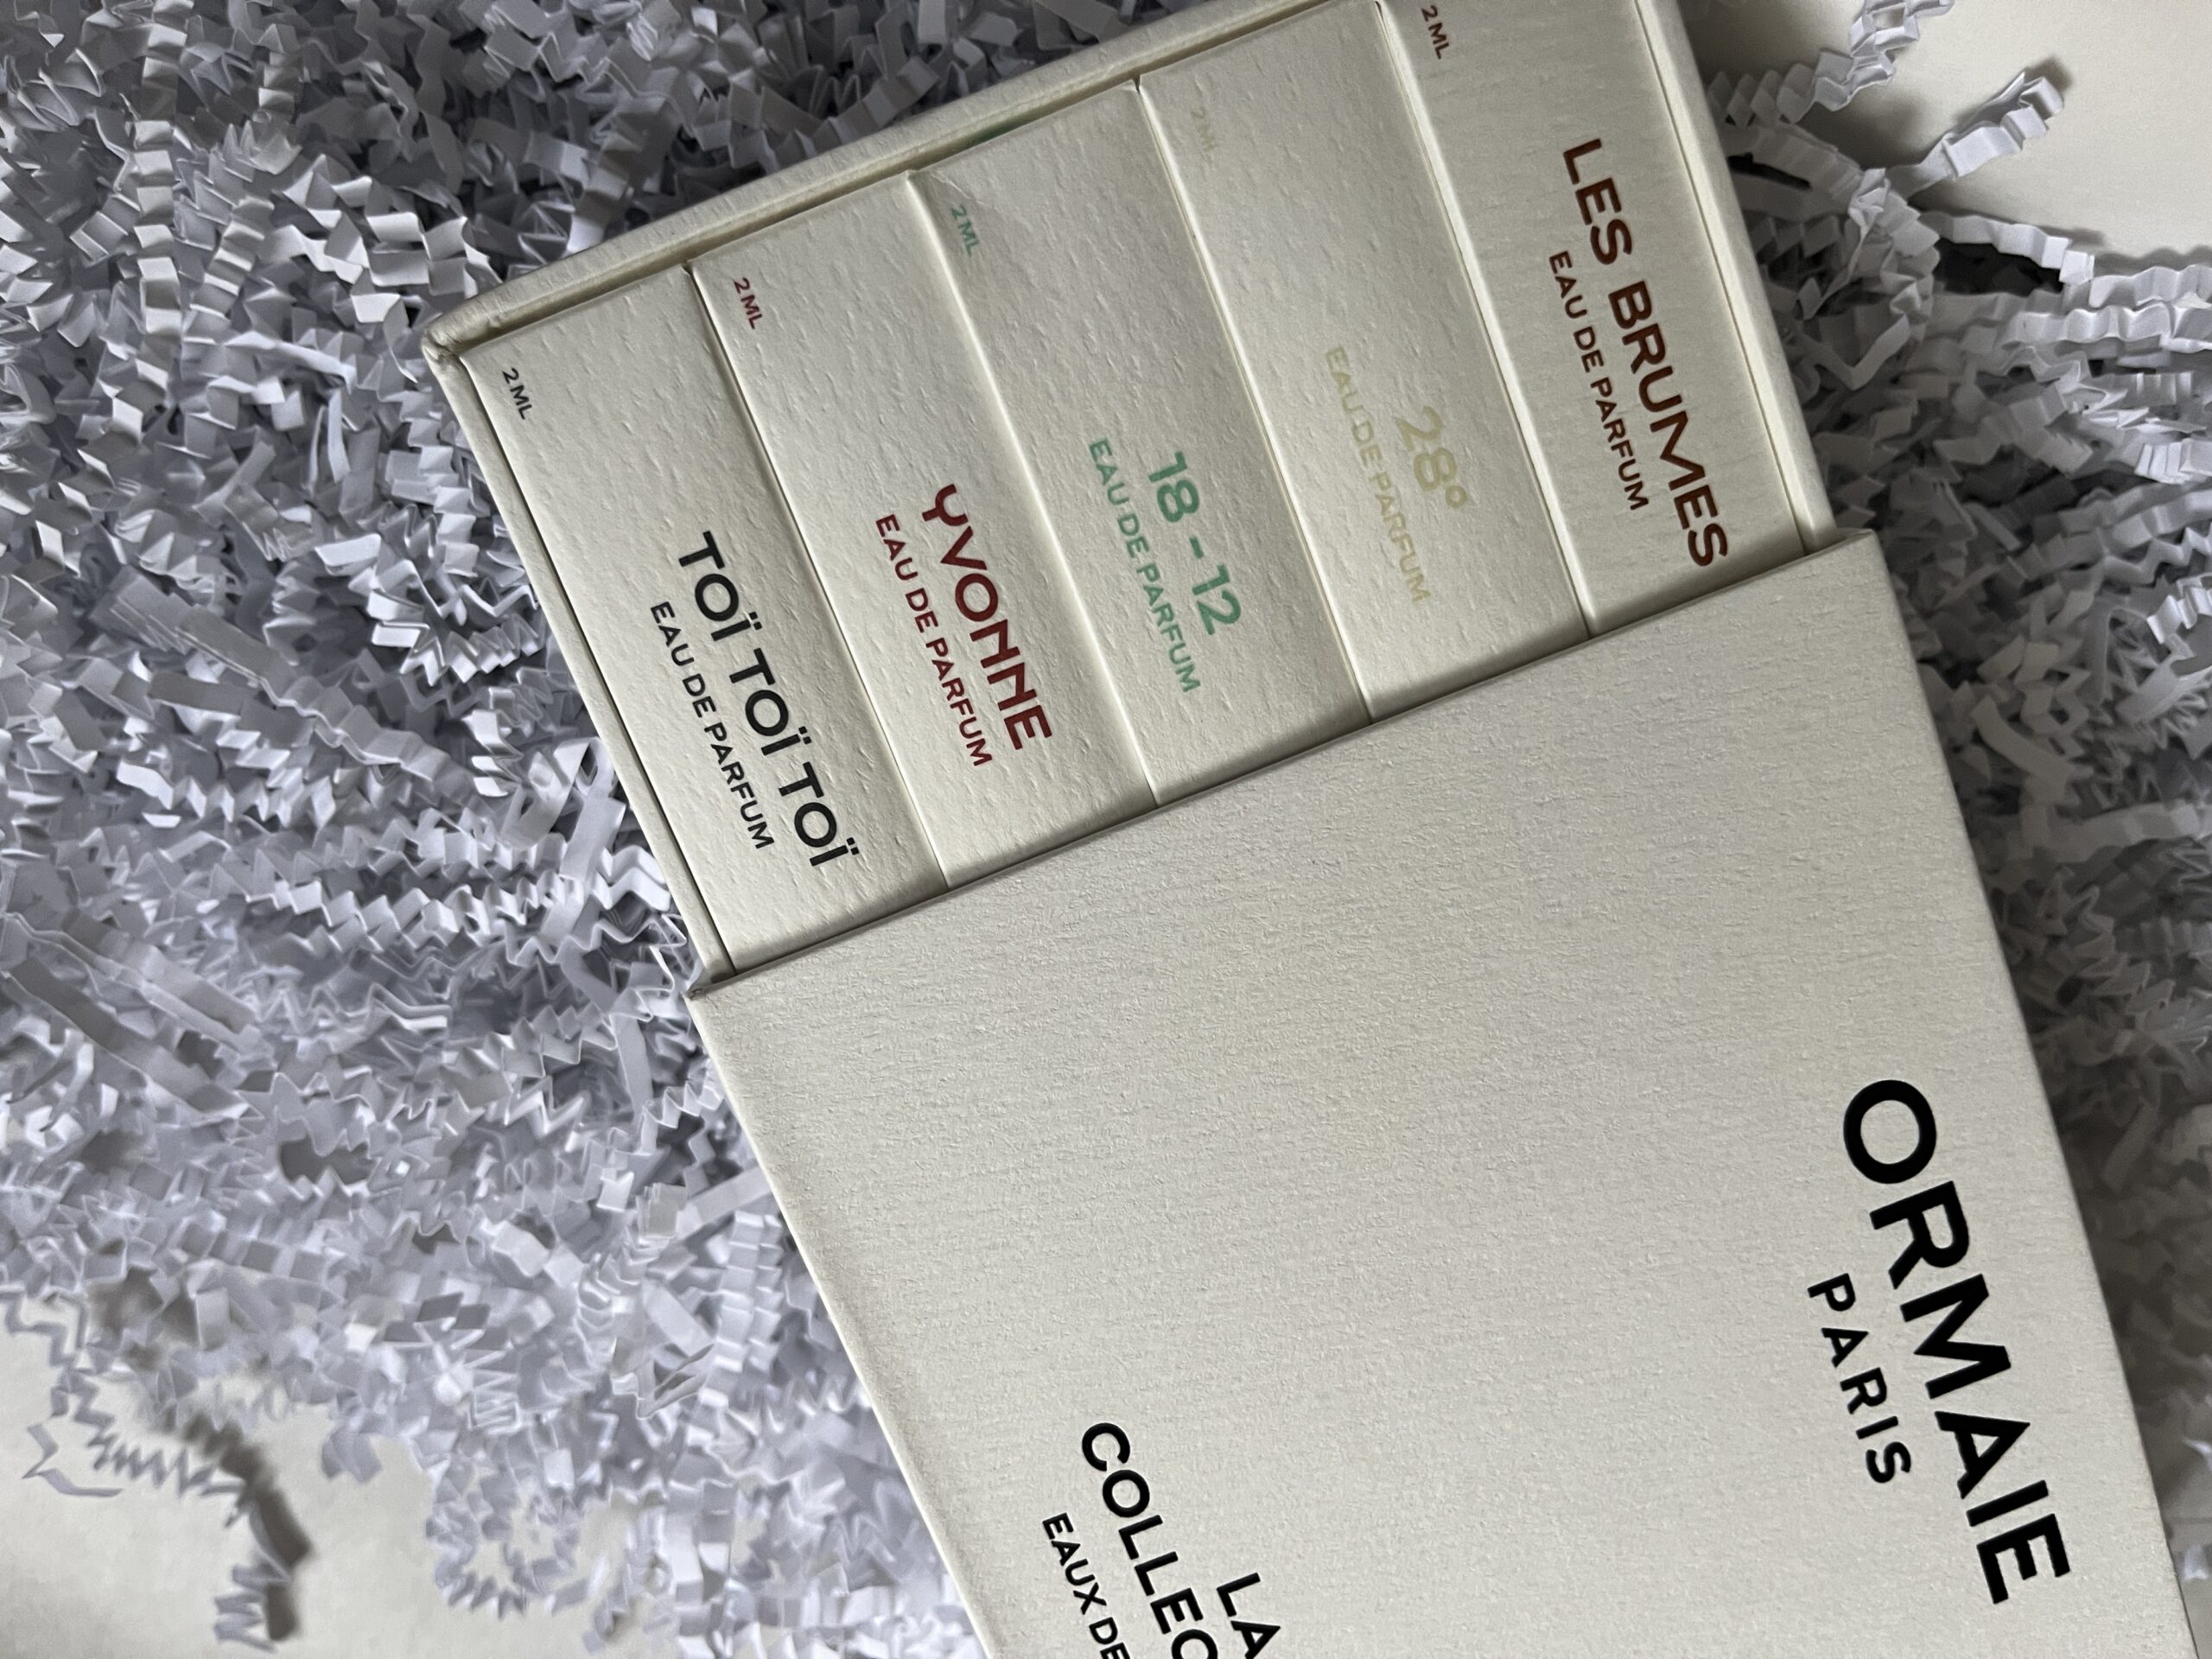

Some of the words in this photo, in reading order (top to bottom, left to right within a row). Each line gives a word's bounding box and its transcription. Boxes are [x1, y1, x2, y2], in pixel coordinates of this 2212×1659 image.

[1325, 346, 1365, 415] EAU
[1351, 420, 1383, 467] DE
[1369, 471, 1432, 602] PARFUM
[1548, 251, 1588, 319] EAU
[1573, 326, 1605, 373] DE
[1590, 377, 1649, 511] PARFUM
[1562, 138, 1633, 265] LES
[1608, 280, 1728, 568] BRUMES
[875, 514, 918, 581] EAU
[905, 588, 939, 633] DE
[925, 638, 993, 766] PARFUM
[921, 483, 1052, 750] YVONNE
[1089, 437, 1130, 505] EAU
[1117, 512, 1150, 558] DE
[1136, 563, 1201, 692] PARFUM
[650, 601, 695, 667] EAU
[682, 673, 717, 718] DE
[704, 722, 775, 849] PARFUM
[678, 531, 762, 641] TOÏ
[729, 647, 811, 756] TOÏ
[779, 761, 860, 867] TOÏ
[1807, 1273, 1911, 1484] PARIS
[1843, 1079, 2071, 1605] ORMAIE
[1042, 1512, 1108, 1615] EAUX
[1217, 1572, 1281, 1659] LA
